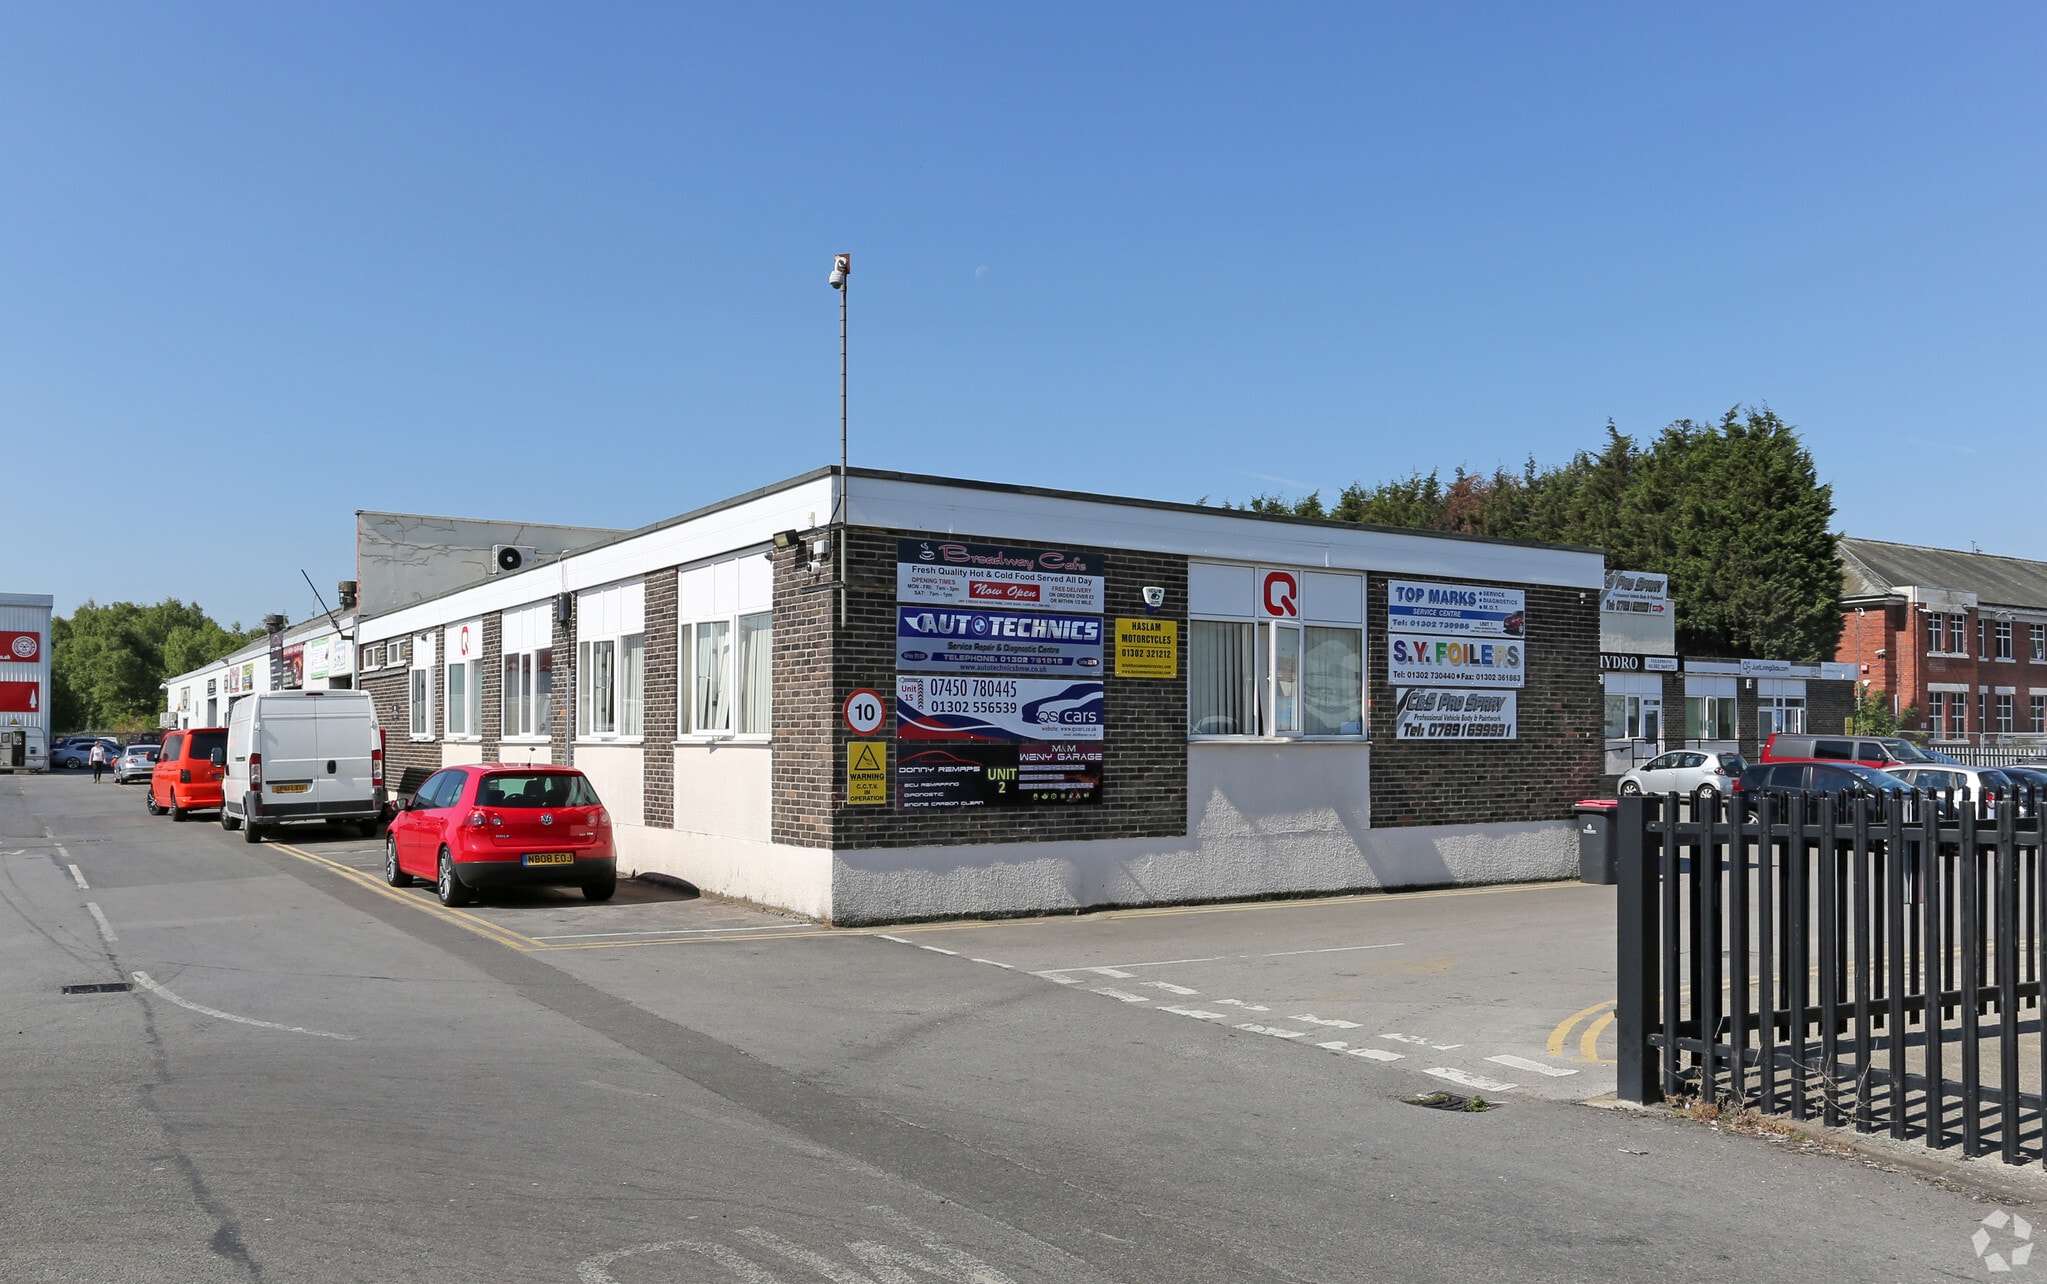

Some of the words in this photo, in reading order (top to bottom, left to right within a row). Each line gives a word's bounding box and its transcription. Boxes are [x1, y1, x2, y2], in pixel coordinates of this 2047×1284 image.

[938, 544, 1034, 571] Broadway
[1039, 552, 1086, 571] Cafe
[912, 565, 936, 575] Fresh
[938, 567, 968, 578] Quality
[969, 569, 984, 578] Hot
[994, 571, 1013, 580] Cold
[1015, 573, 1035, 581] Food
[1037, 574, 1064, 583] Served
[1065, 576, 1076, 584] All
[1077, 577, 1093, 586] Day
[939, 578, 956, 586] TIMES
[973, 583, 1002, 595] Now
[1007, 586, 1037, 599] Open
[1066, 586, 1092, 594] DELIVERY
[1263, 571, 1297, 617] Q
[1396, 586, 1425, 603] TOP
[1428, 589, 1477, 606] MARKS
[1483, 598, 1518, 606] DIAGNOSTICS
[1412, 608, 1437, 616] SERVICE
[1438, 609, 1461, 618] CENTRE
[1131, 622, 1161, 631] HASLAM
[1410, 620, 1437, 628] 01302
[1121, 634, 1172, 645] MOTORCYCLES
[947, 641, 972, 651] Service
[973, 642, 996, 652] Repair
[996, 643, 1002, 651] &
[1003, 643, 1037, 654] Diagnostic
[1037, 645, 1060, 654] Centre
[1393, 639, 1431, 664] S.Y.
[1435, 642, 1520, 667] FOILERS
[943, 653, 998, 662] TELEPHONE:
[1000, 656, 1028, 664] 01302
[1121, 648, 1144, 657] 01302
[1146, 649, 1171, 659] 321212
[960, 663, 1047, 673] www.autotechnicsbmw.co.uk
[1393, 671, 1406, 679] Tel:
[1407, 671, 1429, 679] 01302
[1430, 672, 1455, 680] 730440
[930, 678, 967, 697] 07450
[972, 679, 1017, 698] 780445
[855, 703, 875, 721] 10
[931, 700, 969, 713] 01302
[973, 701, 1017, 713] 556539
[1038, 711, 1059, 723] QS
[1064, 711, 1097, 723] cars
[1414, 713, 1443, 721] Professional
[1403, 722, 1424, 737] Tel:
[1057, 753, 1103, 761] GARAGE
[898, 766, 935, 774] DONNY
[987, 767, 1017, 780] UNIT
[849, 773, 885, 781] WARNING
[998, 781, 1006, 794] 2
[850, 794, 884, 802] OPERATION
[528, 854, 553, 864] NB08
